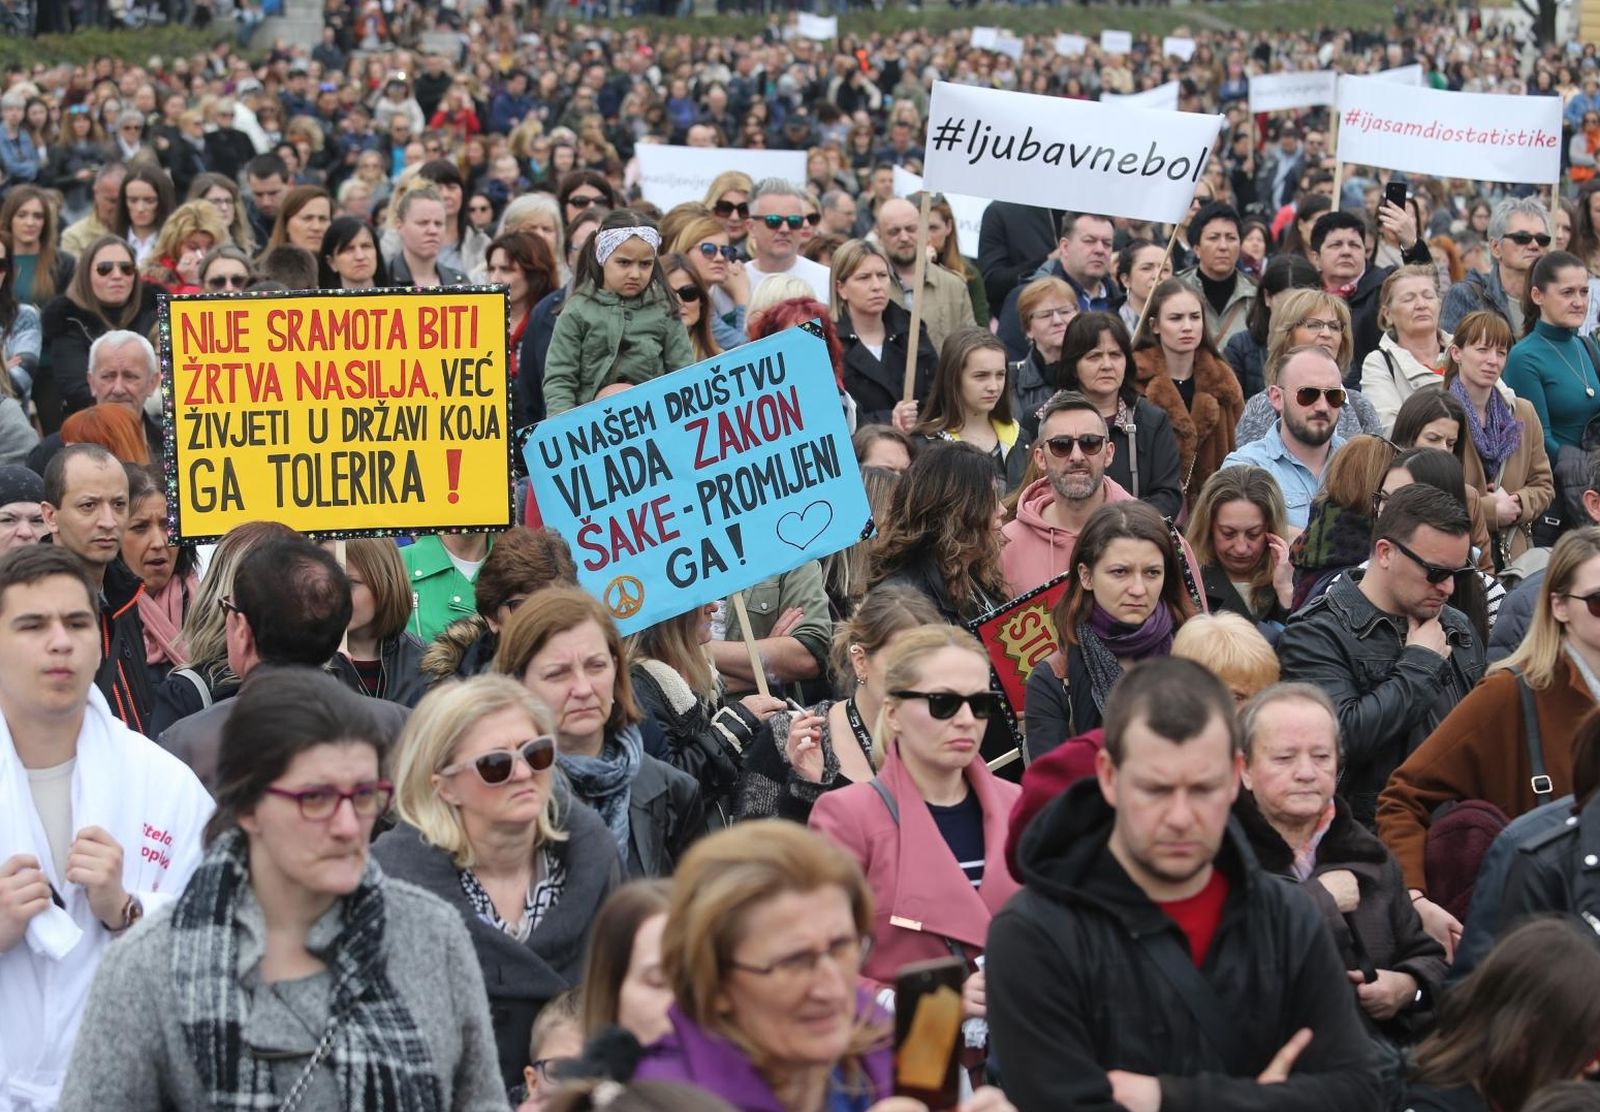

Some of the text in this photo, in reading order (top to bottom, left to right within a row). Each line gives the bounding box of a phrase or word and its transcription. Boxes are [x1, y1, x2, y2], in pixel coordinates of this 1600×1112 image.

[932, 117, 1209, 183] #ljubavnebol
[1344, 109, 1558, 148] #ijasamdiostatistike
[181, 305, 478, 354] NIJE SRAMOTA BITI
[183, 351, 494, 405] ŽRTVA NASILJA, VEĆ
[184, 400, 501, 450] ŽIVJETI U DRŽAVI KOJA
[538, 351, 787, 470] U NAŠEM DRUŠTVU
[552, 385, 804, 518] VLADA ZAKON
[188, 457, 245, 513] GA
[267, 450, 425, 508] TOLERIRA
[576, 494, 681, 572] ŠAKE
[1009, 611, 1058, 667] STO
